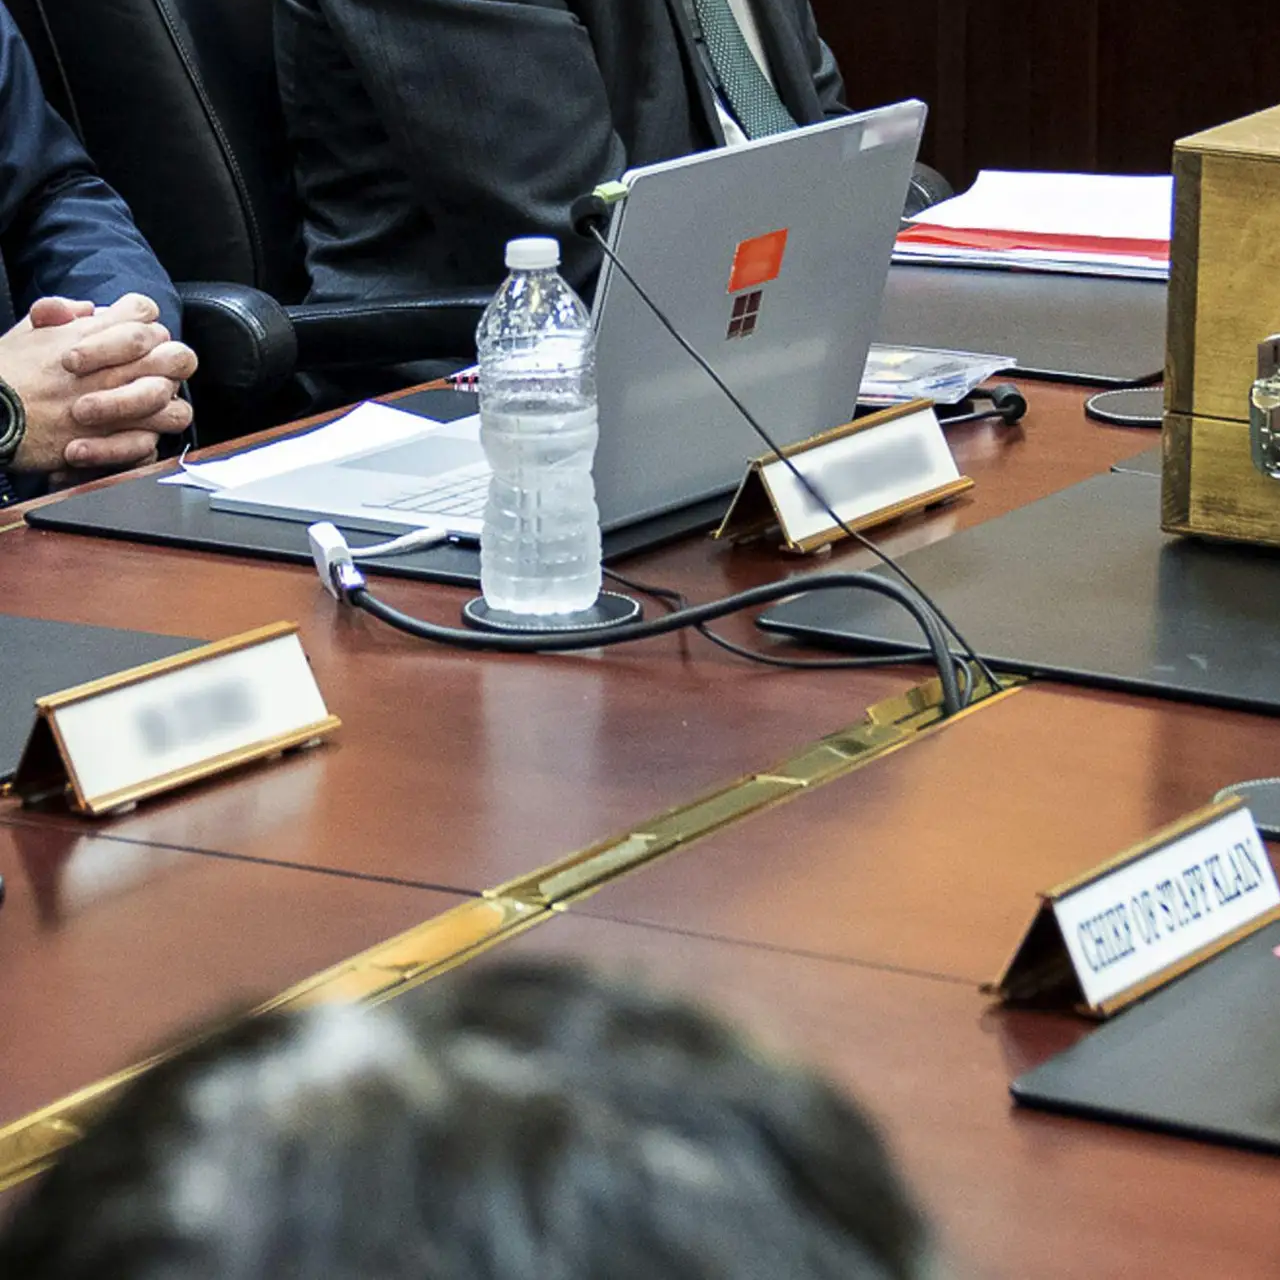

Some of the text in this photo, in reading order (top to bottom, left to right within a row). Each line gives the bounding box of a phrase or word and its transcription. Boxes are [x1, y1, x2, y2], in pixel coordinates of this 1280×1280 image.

[1077, 836, 1265, 973] CHIEF OF STAFF KLAIN
